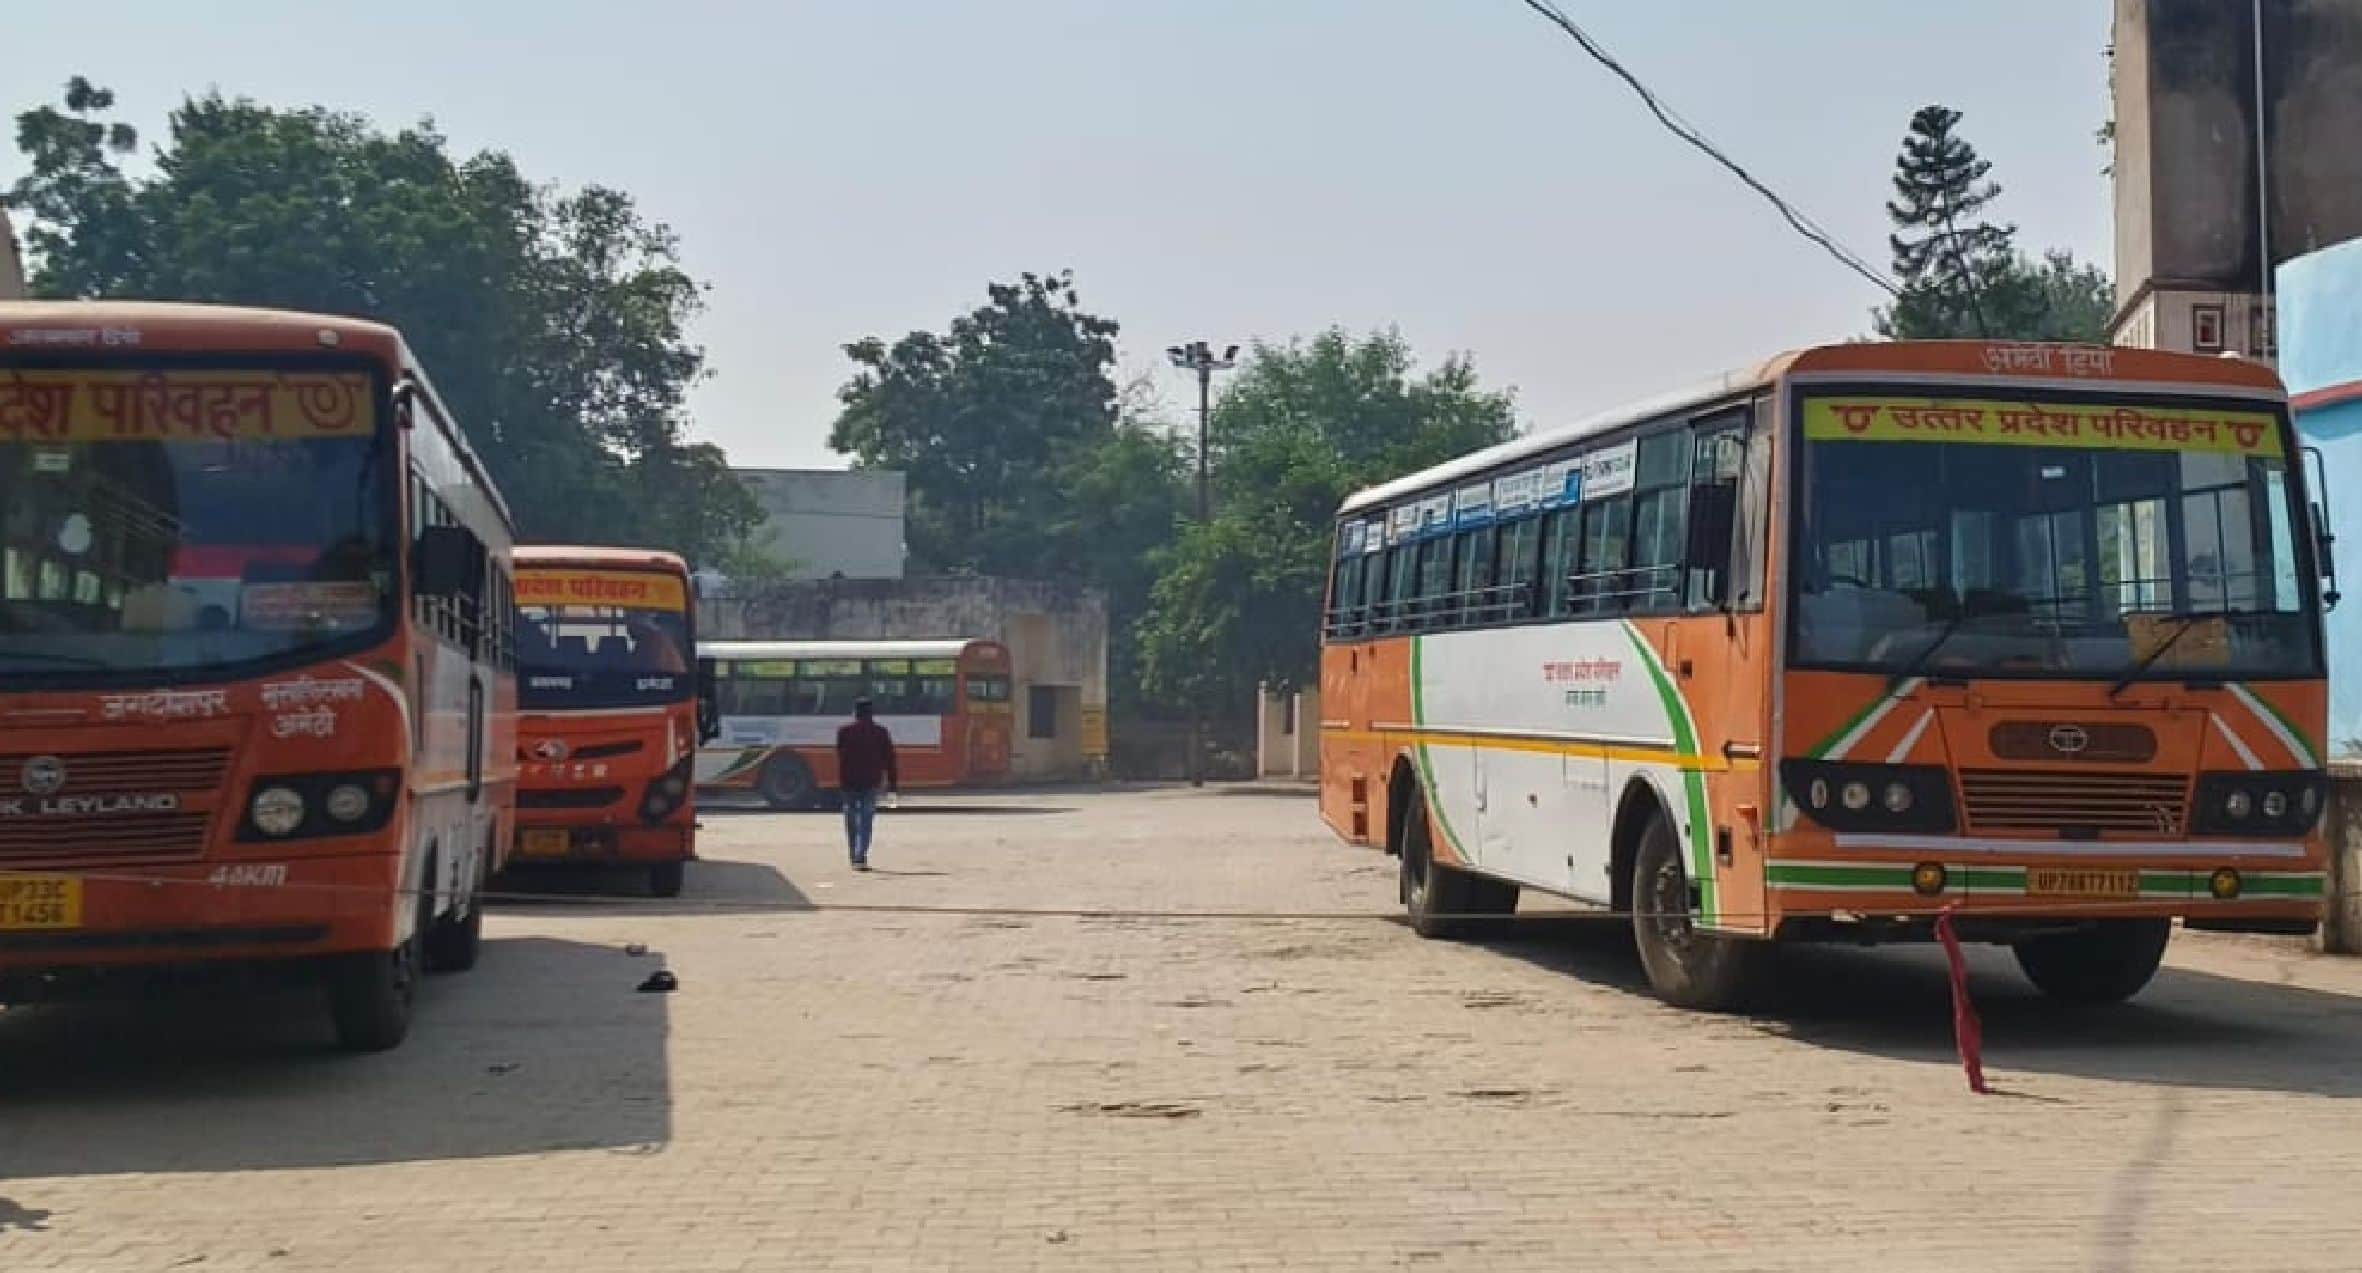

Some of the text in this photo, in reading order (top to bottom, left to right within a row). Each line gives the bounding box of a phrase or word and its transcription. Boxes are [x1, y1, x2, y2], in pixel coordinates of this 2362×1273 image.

[86, 371, 277, 437] परिवहन
[1888, 403, 2217, 443] उत्तर प्रदेश परिवहन
[40, 793, 178, 813] LEYLAND
